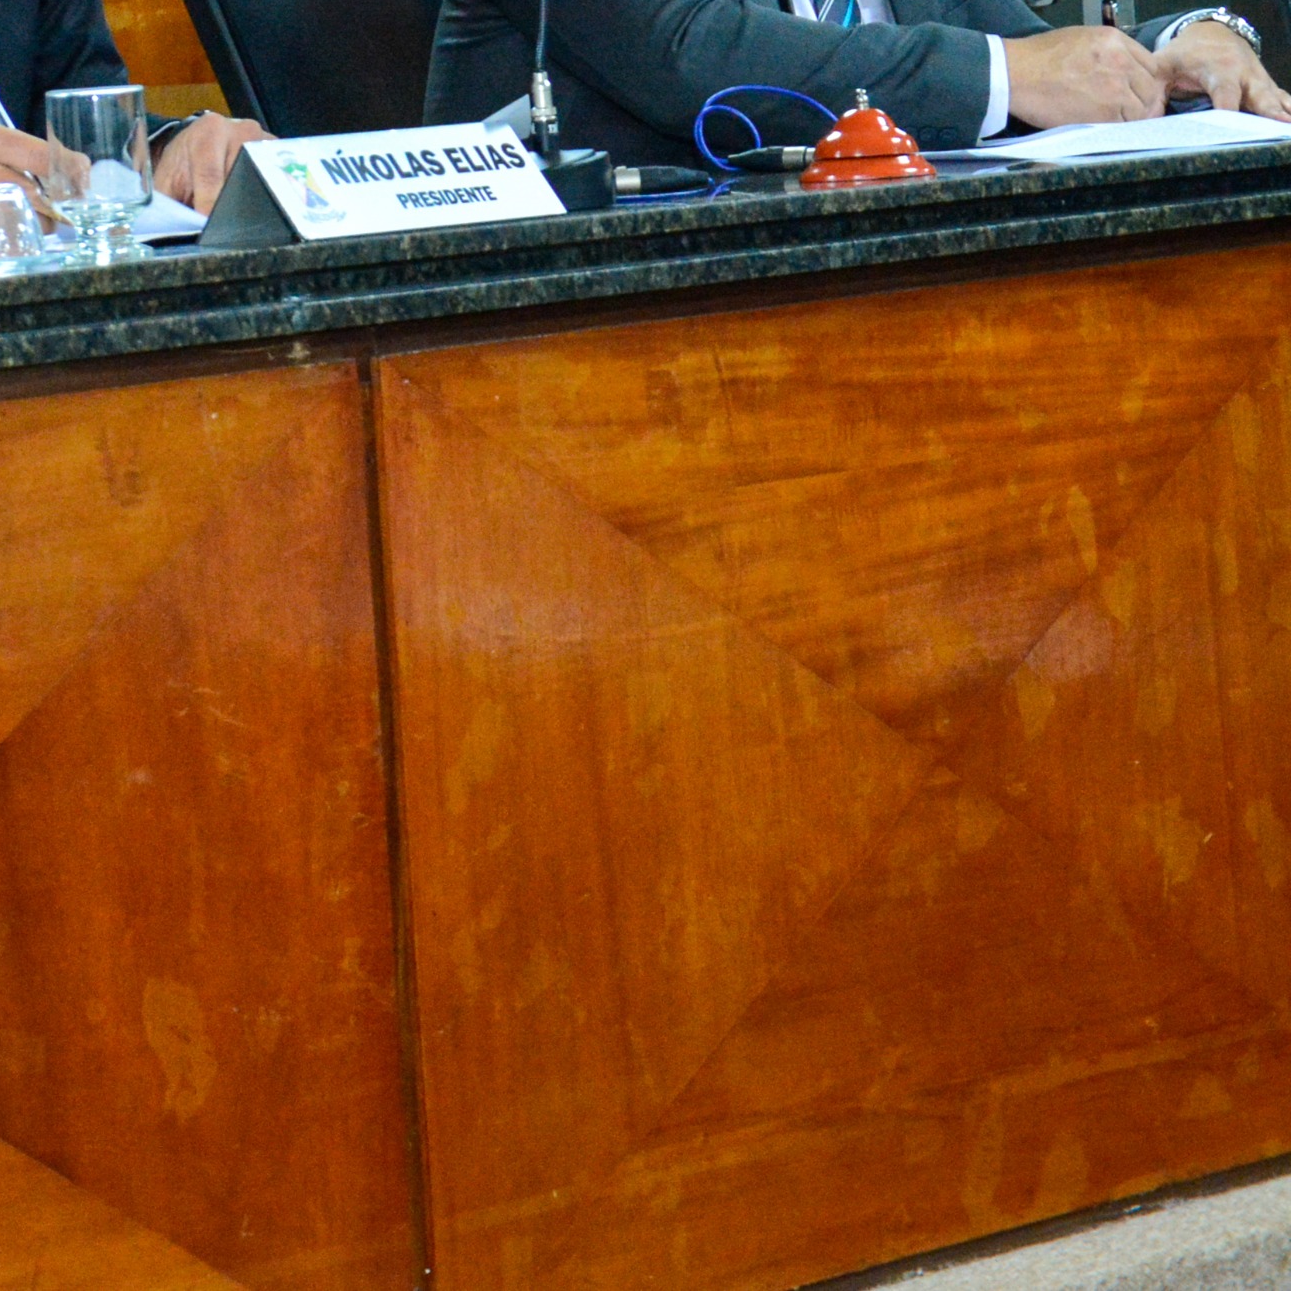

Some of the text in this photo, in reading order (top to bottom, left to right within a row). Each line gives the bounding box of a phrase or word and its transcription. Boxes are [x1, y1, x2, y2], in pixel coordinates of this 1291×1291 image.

[320, 142, 526, 185] NÍKOLAS ELIAS
[396, 185, 498, 210] PRESIDENTE
